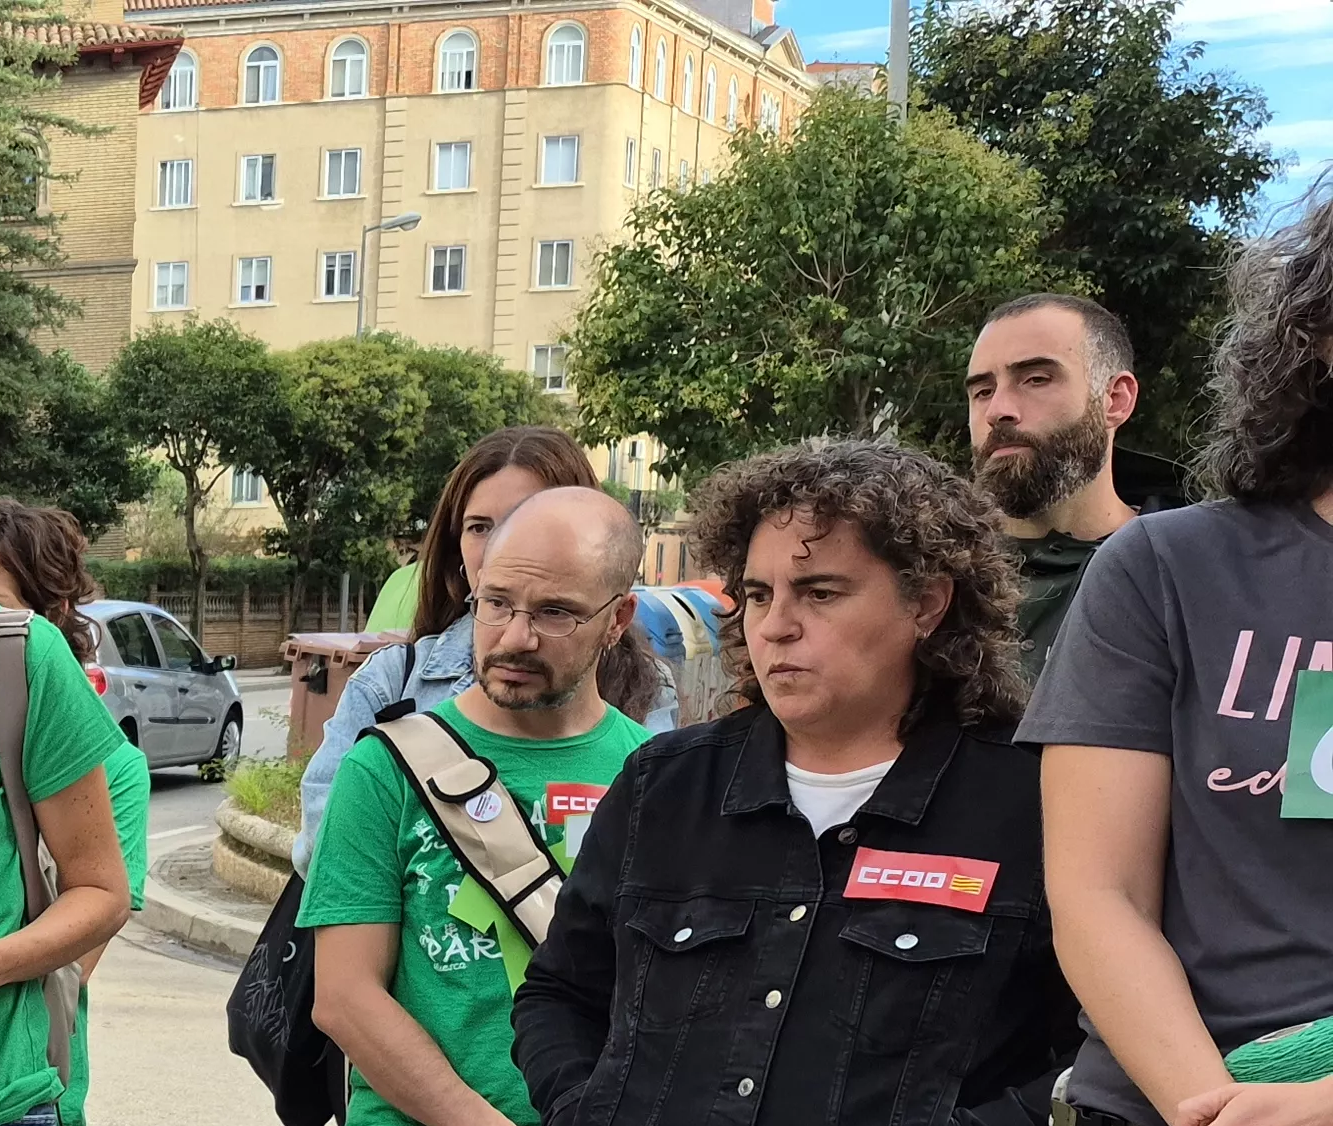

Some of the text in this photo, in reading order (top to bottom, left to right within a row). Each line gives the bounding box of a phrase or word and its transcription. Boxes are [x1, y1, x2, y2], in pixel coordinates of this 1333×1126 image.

[553, 796, 600, 812] CCO
[856, 866, 946, 889] CCOO
[427, 933, 503, 962] PAR
